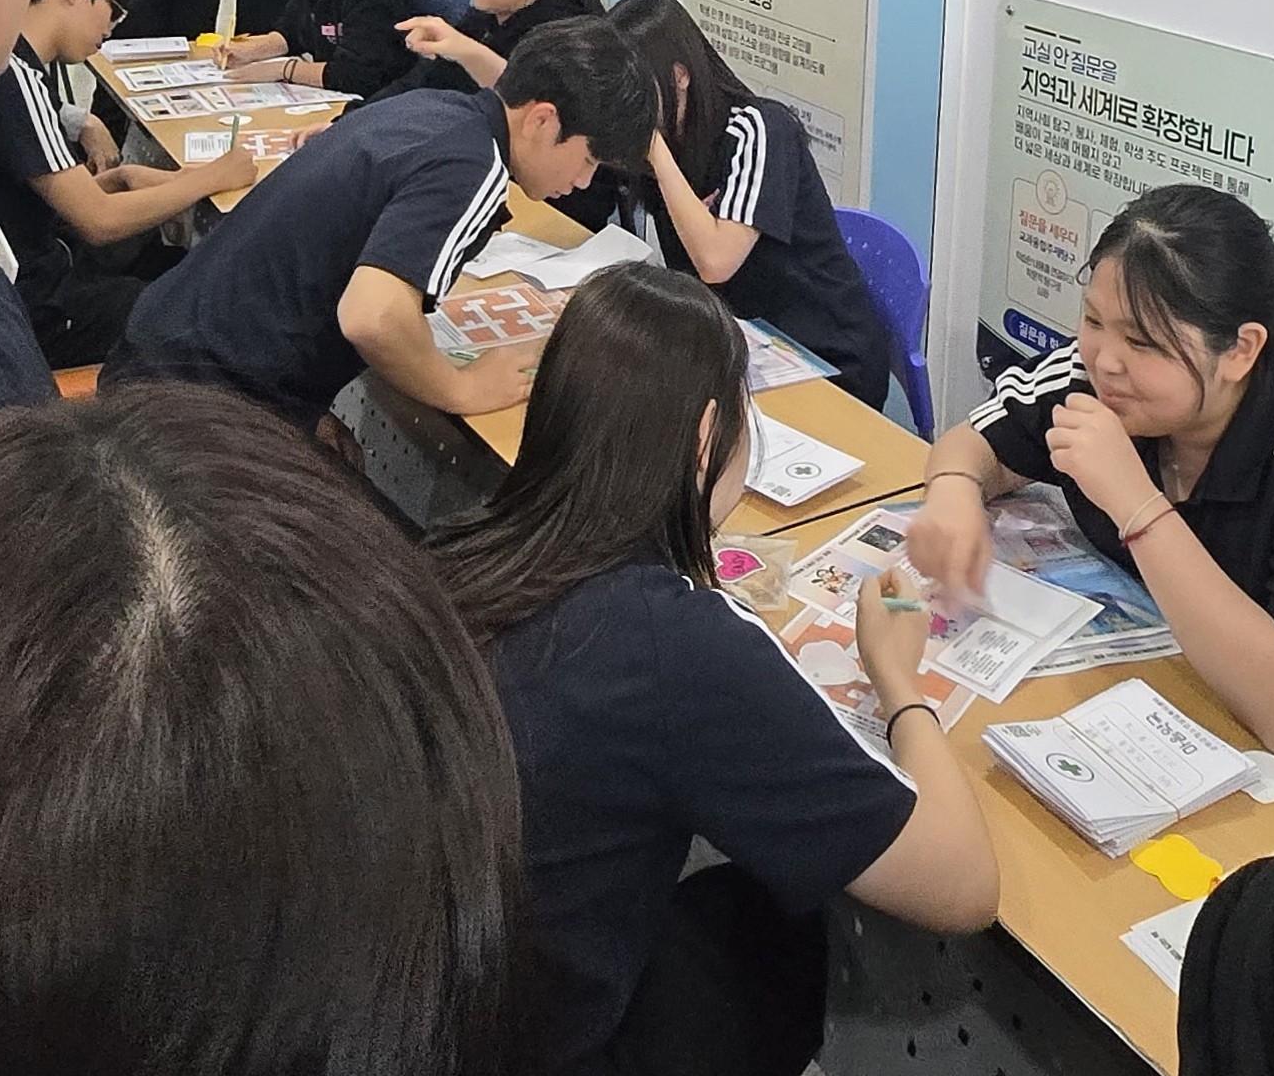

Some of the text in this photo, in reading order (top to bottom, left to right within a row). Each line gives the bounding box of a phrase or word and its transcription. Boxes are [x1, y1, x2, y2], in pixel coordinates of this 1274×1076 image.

[1022, 38, 1118, 84] 교실 안 질문을
[1021, 66, 1255, 166] 지역과 세계로 확장합니다
[1147, 149, 1167, 168] 주도
